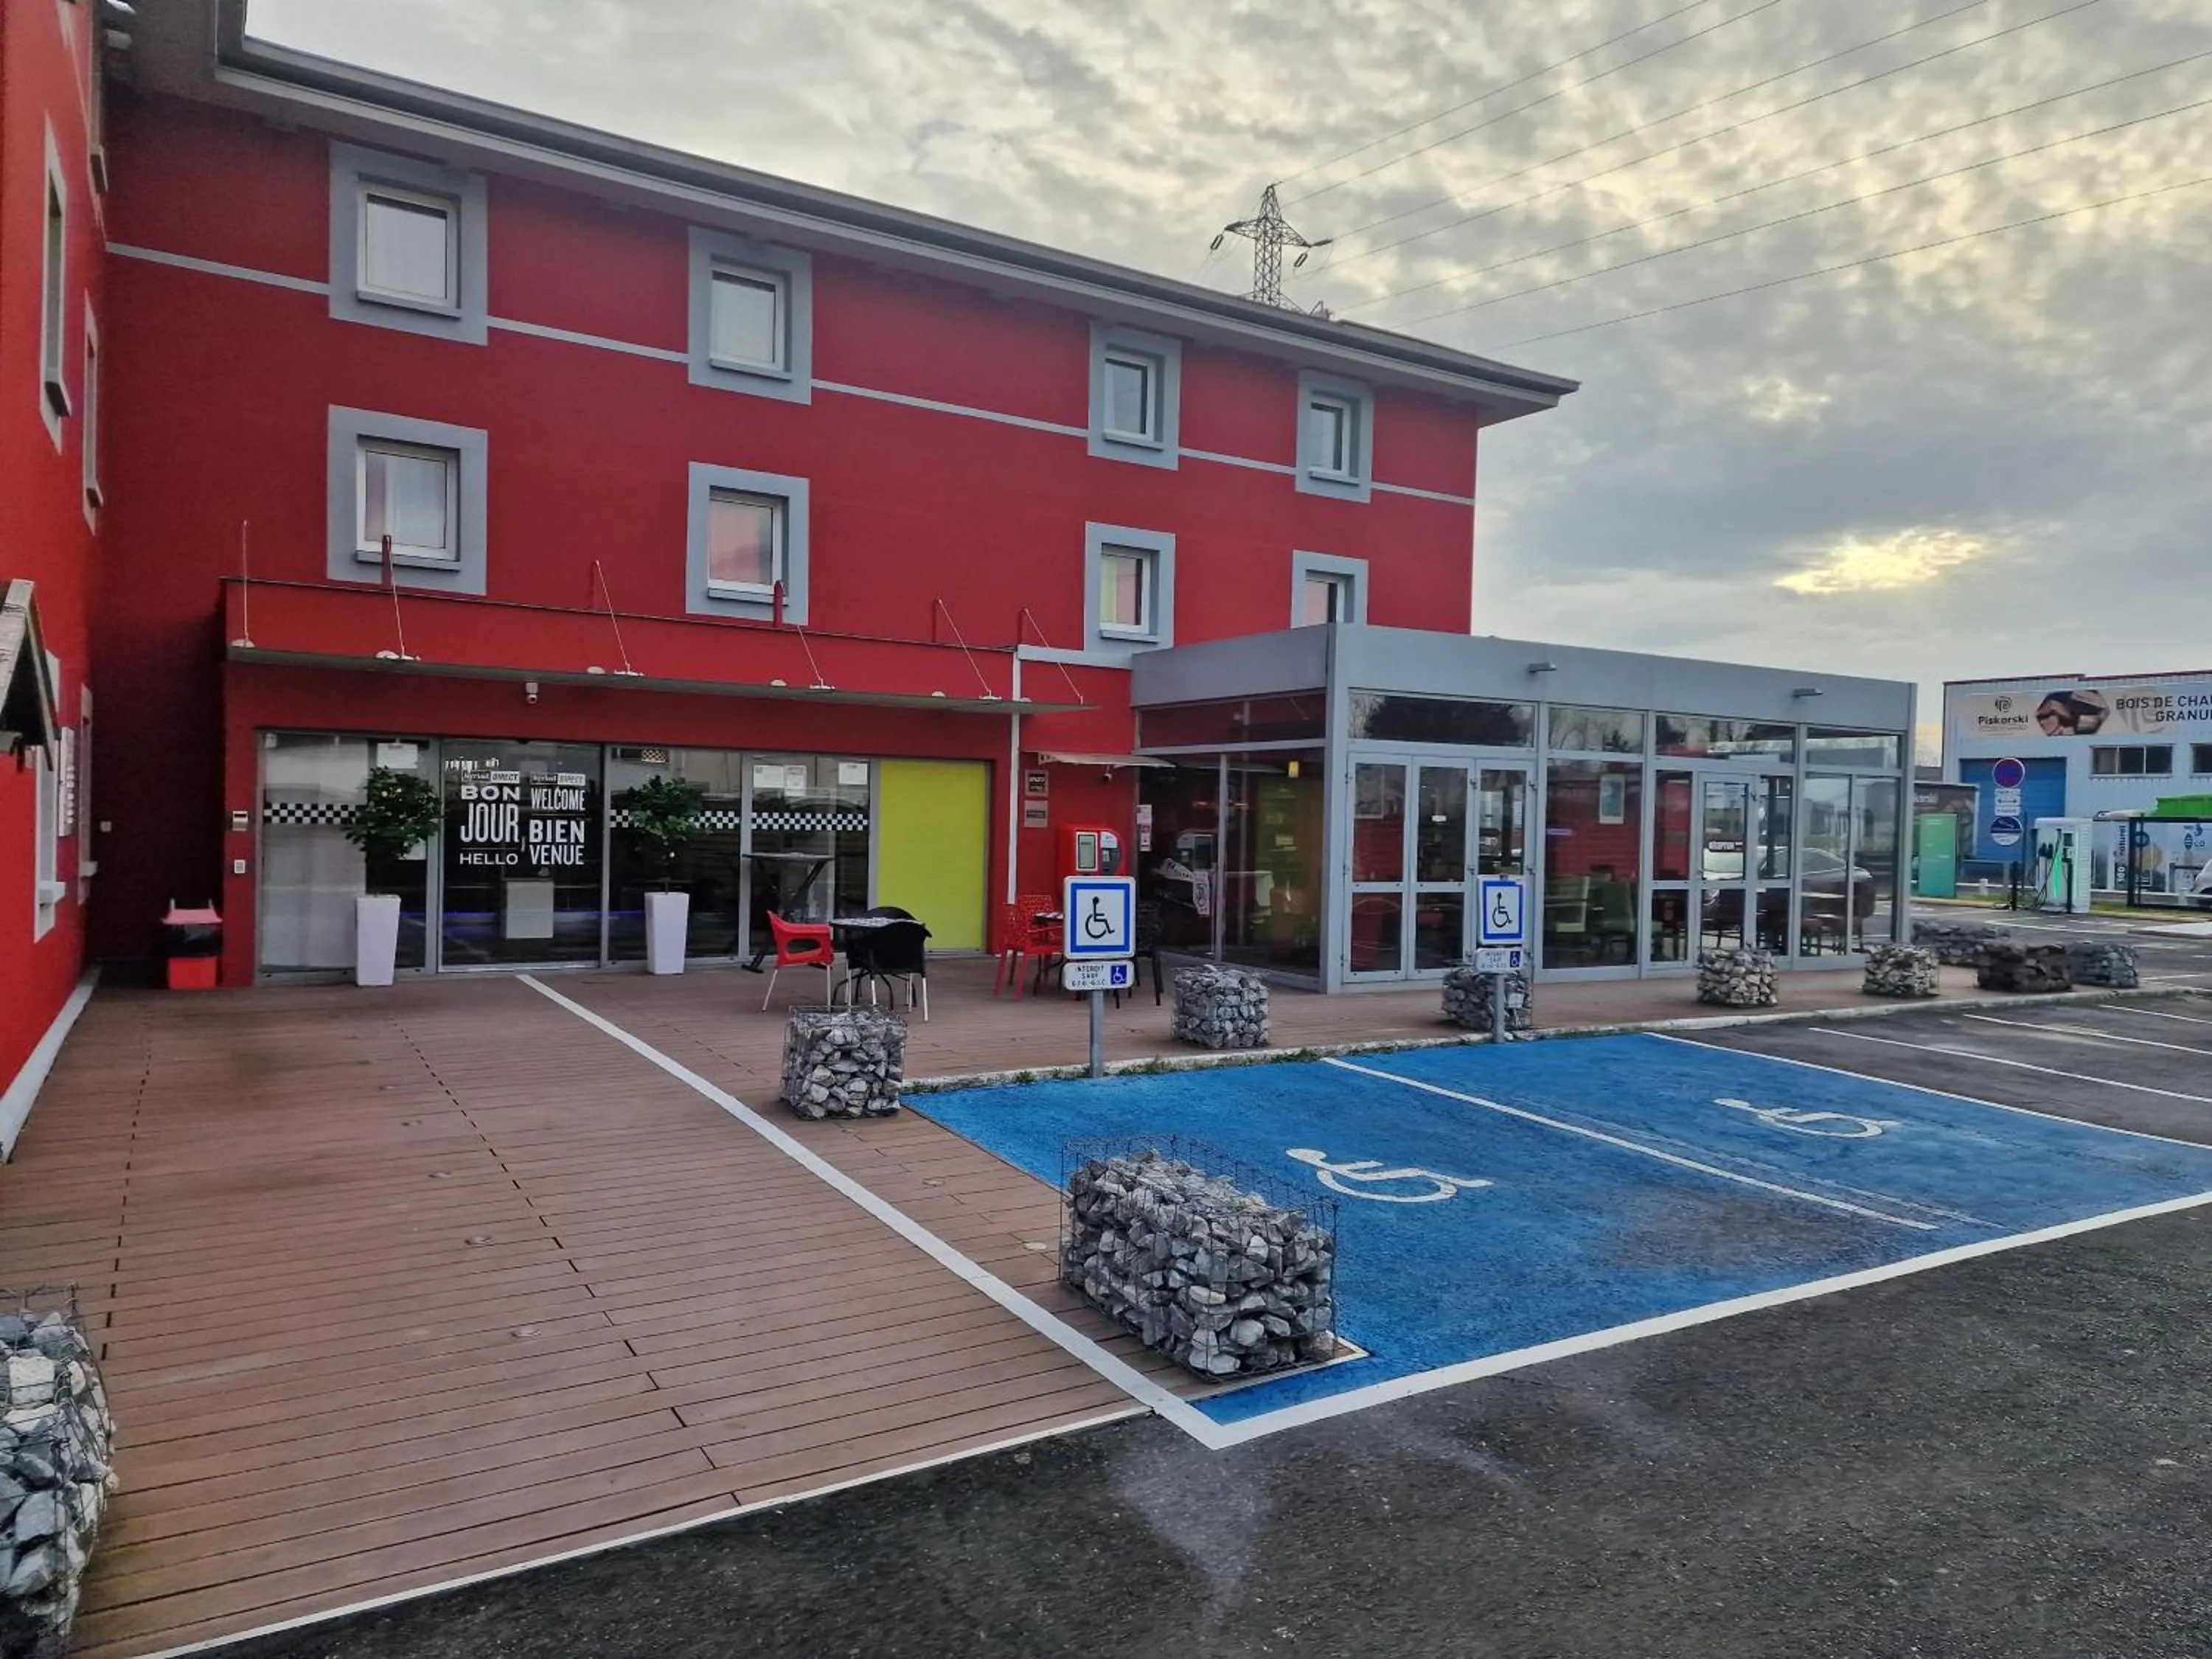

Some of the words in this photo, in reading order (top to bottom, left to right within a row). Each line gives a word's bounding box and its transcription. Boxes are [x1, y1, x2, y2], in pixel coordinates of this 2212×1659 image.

[2116, 697, 2149, 709] BOIS
[2154, 696, 2173, 708] DE
[2177, 695, 2212, 707] CHA
[1978, 714, 2028, 726] Piskorski
[2155, 709, 2212, 721] GRANU
[461, 785, 520, 801] BON
[531, 787, 586, 811] WELCOME
[529, 819, 585, 844] BIEN
[459, 853, 518, 865] HELLO
[529, 844, 585, 865] VENUE
